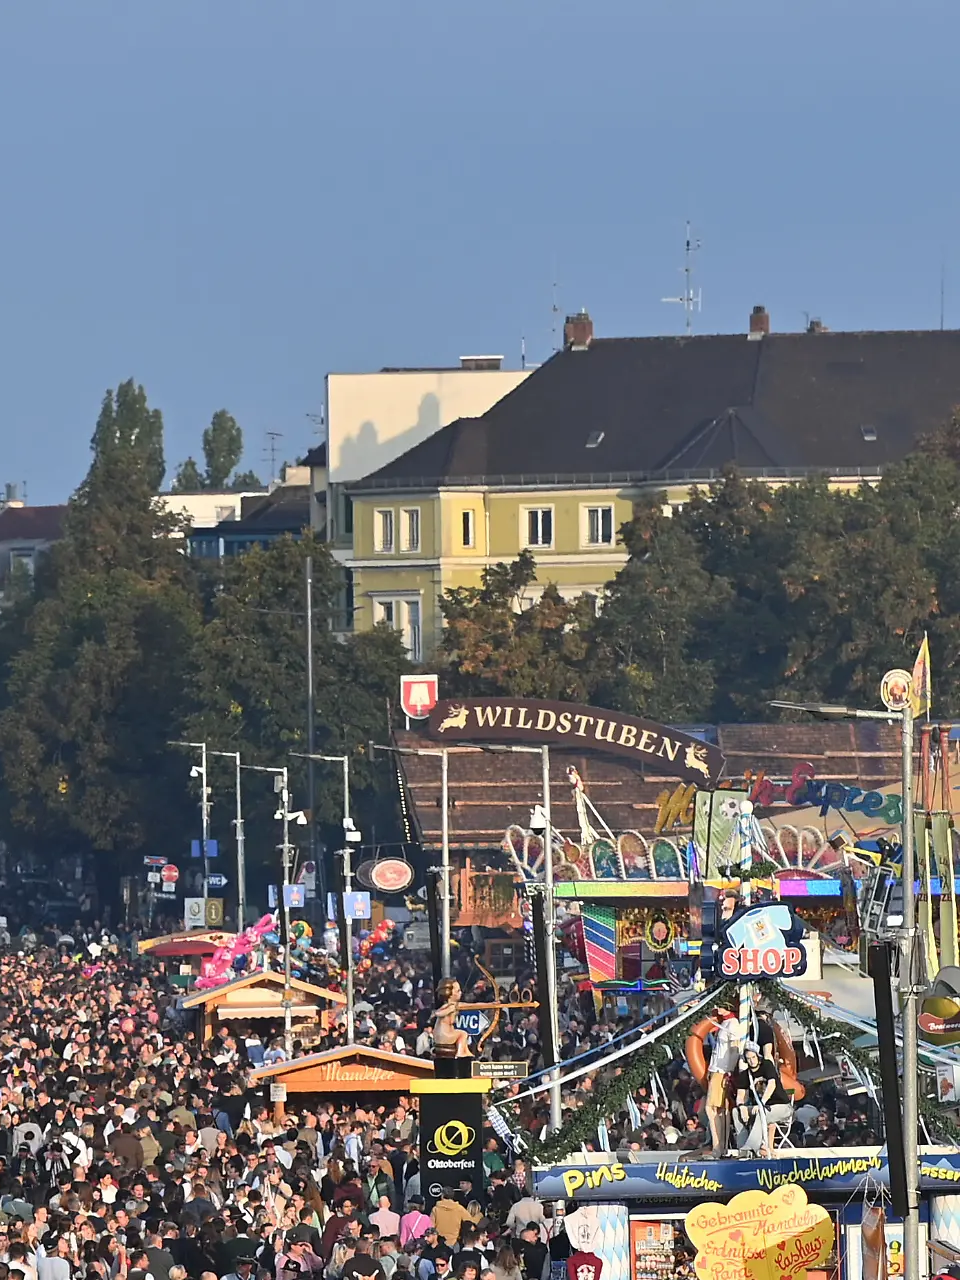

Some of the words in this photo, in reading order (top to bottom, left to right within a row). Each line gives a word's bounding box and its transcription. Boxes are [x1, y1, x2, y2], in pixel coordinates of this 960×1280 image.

[473, 705, 682, 762] WILDSTUBEN
[209, 876, 221, 885] WC
[722, 948, 801, 976] SHOP
[456, 1014, 478, 1029] WC
[321, 1061, 395, 1083] Mandelfee
[427, 1159, 475, 1169] Oktoberfest
[562, 1162, 627, 1198] Pins
[654, 1162, 723, 1192] Halstücher
[756, 1156, 882, 1189] Wäscheklammern
[696, 1203, 775, 1229] Gebrannte
[752, 1210, 819, 1237] Mandeln
[704, 1237, 766, 1259] Erdnüsse
[774, 1235, 823, 1271] Cashew
